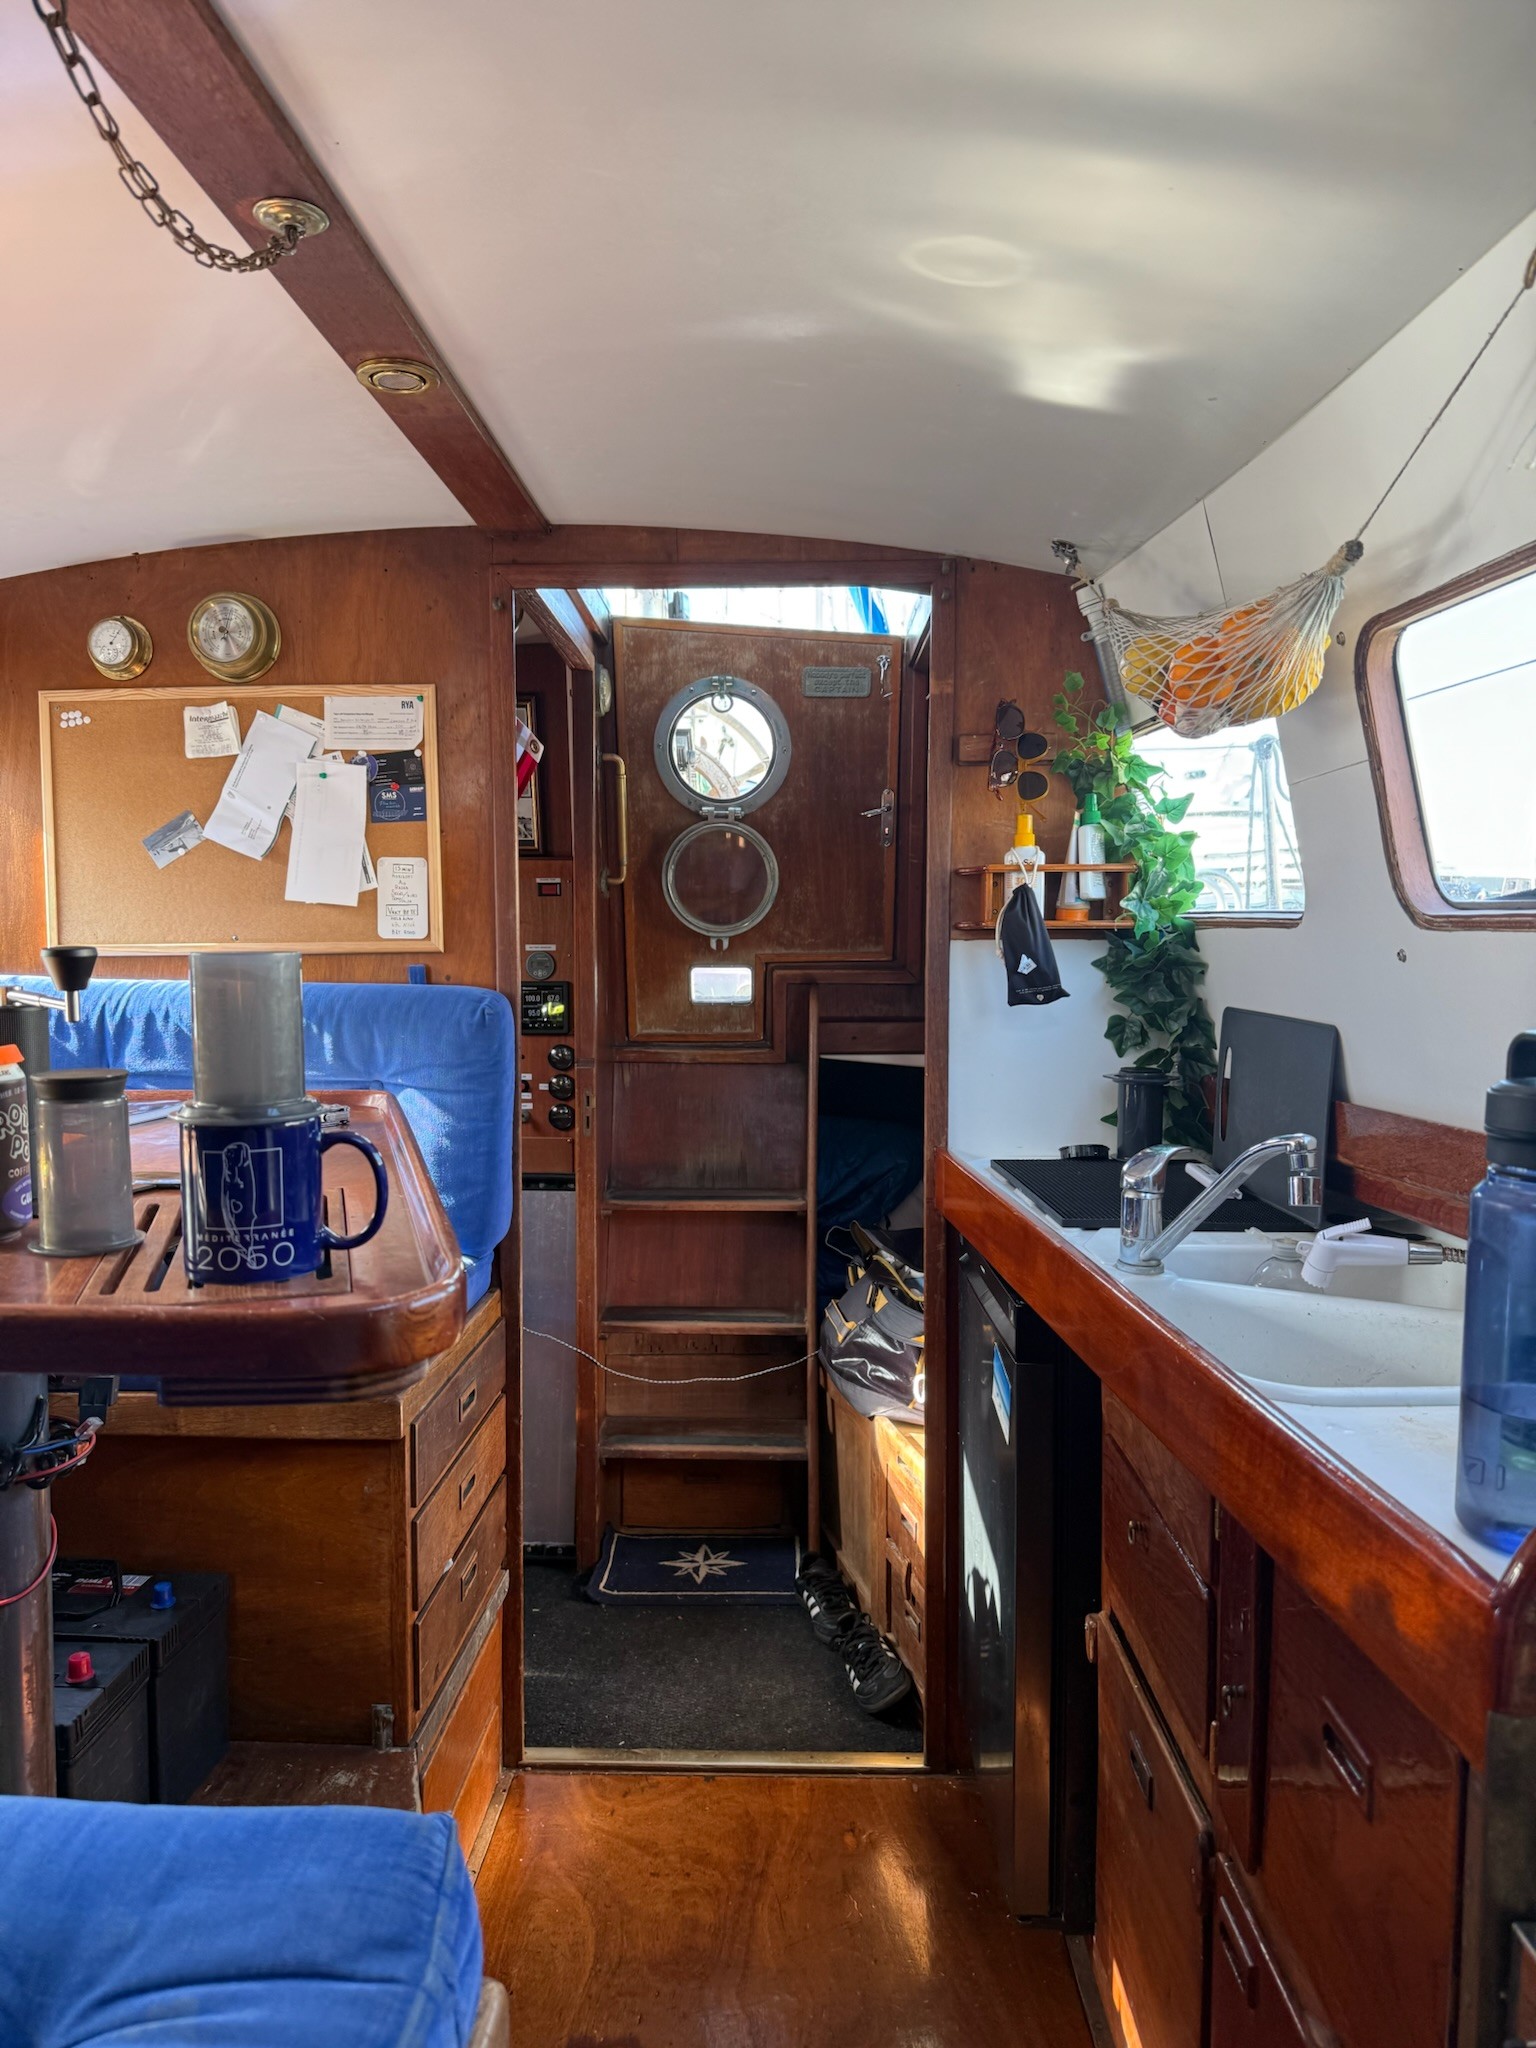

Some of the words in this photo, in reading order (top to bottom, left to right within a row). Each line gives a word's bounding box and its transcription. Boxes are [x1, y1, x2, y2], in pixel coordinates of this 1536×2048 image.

[401, 701, 414, 709] RYA
[381, 791, 397, 799] SMS
[196, 1241, 295, 1272] 2050
